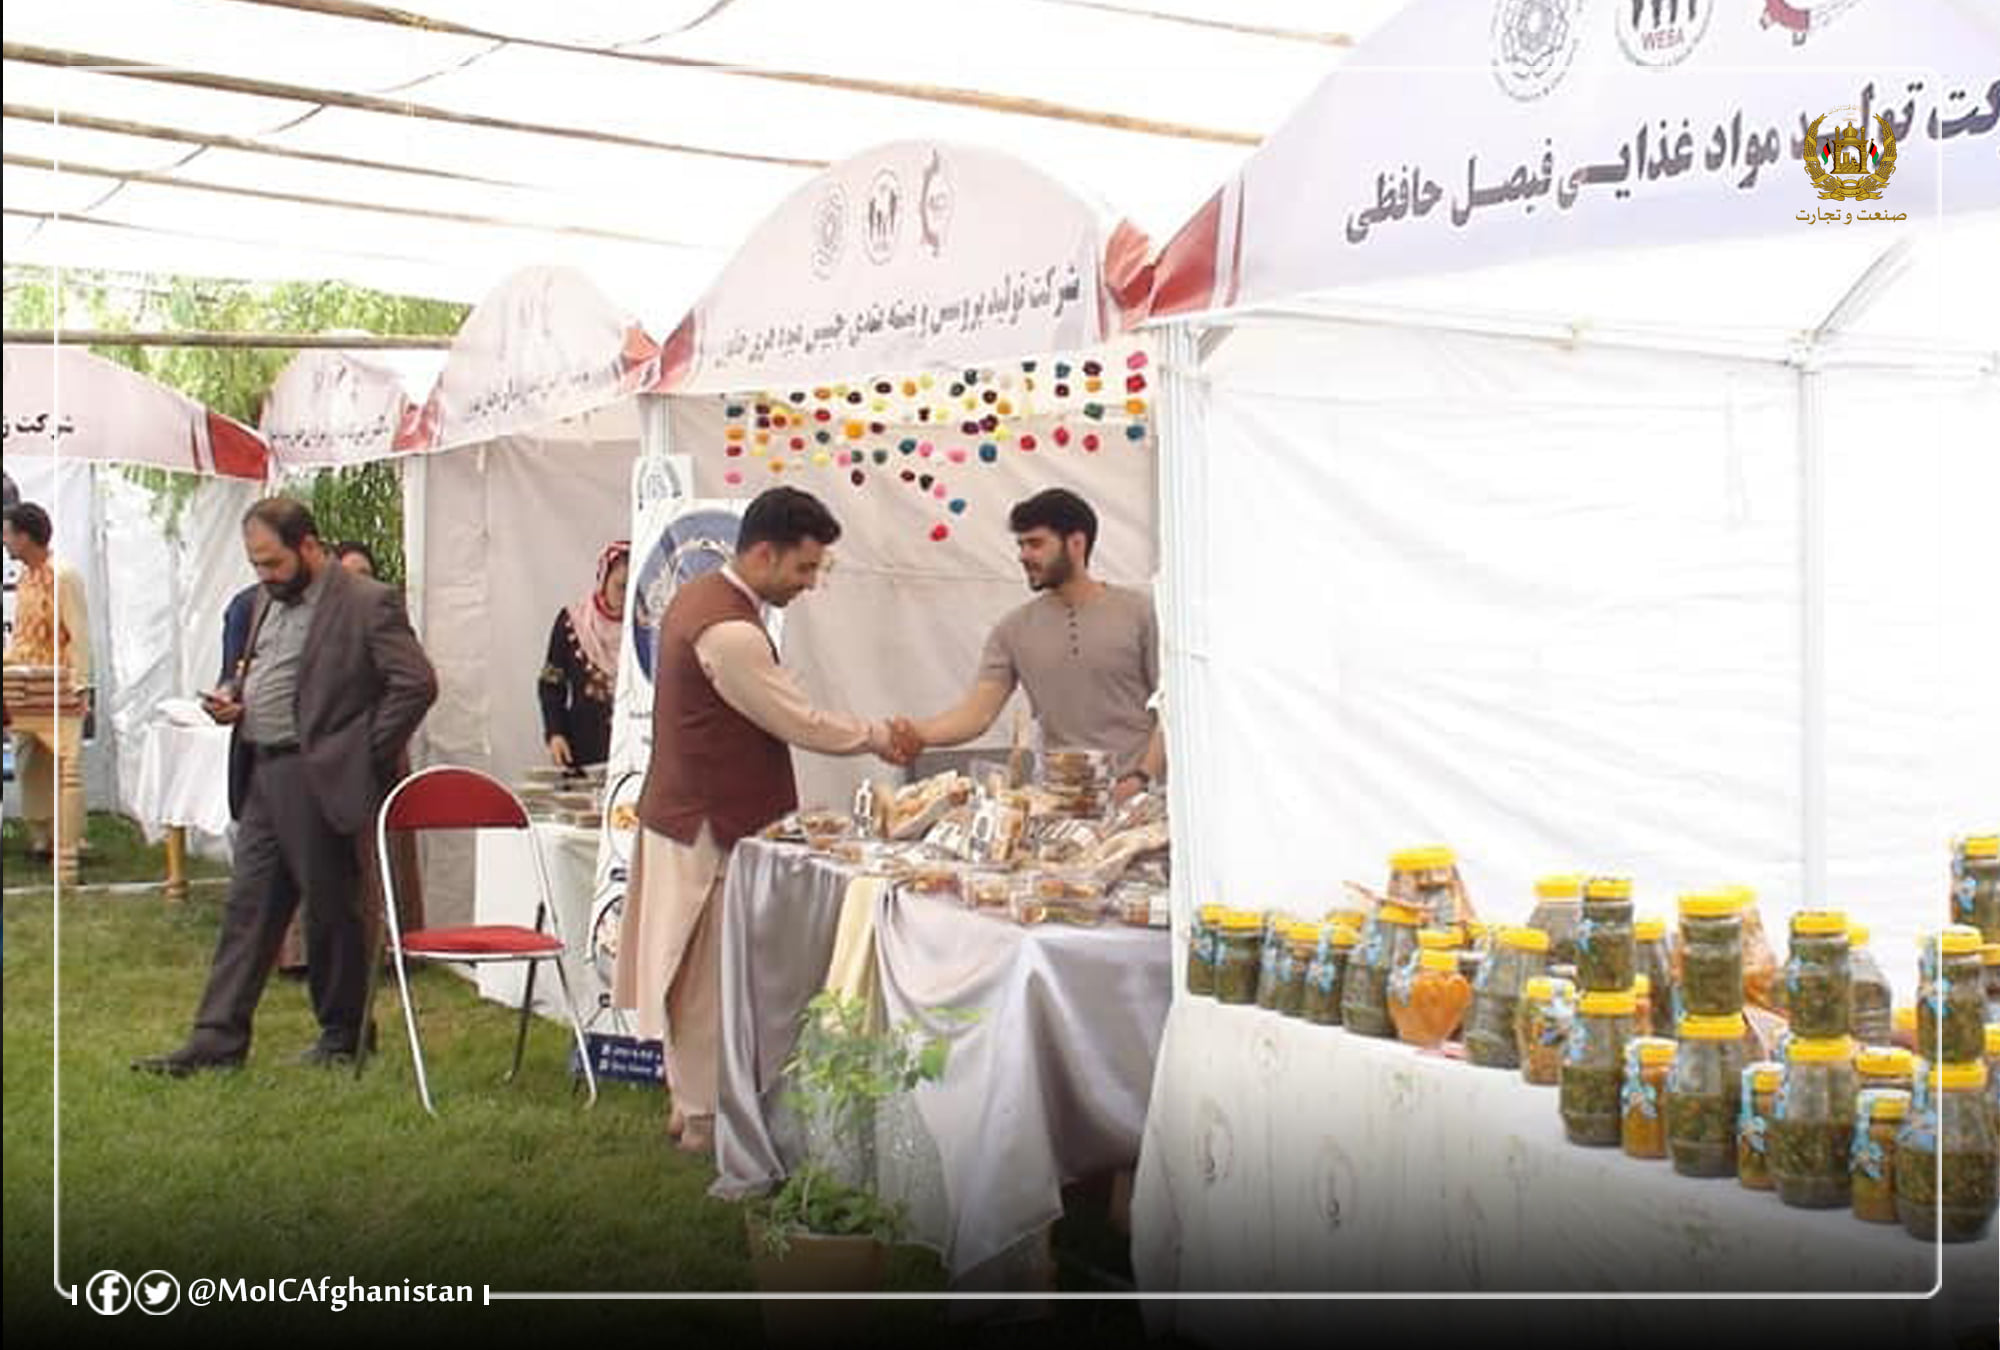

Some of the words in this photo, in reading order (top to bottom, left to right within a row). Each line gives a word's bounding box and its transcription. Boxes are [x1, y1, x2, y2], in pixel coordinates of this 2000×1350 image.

[1451, 137, 1553, 227] فیصل
[1557, 117, 1694, 210] غذایی
[1704, 107, 1781, 190] مواد
[1346, 164, 1444, 245] حافظی
[15, 412, 75, 440] شرکت
